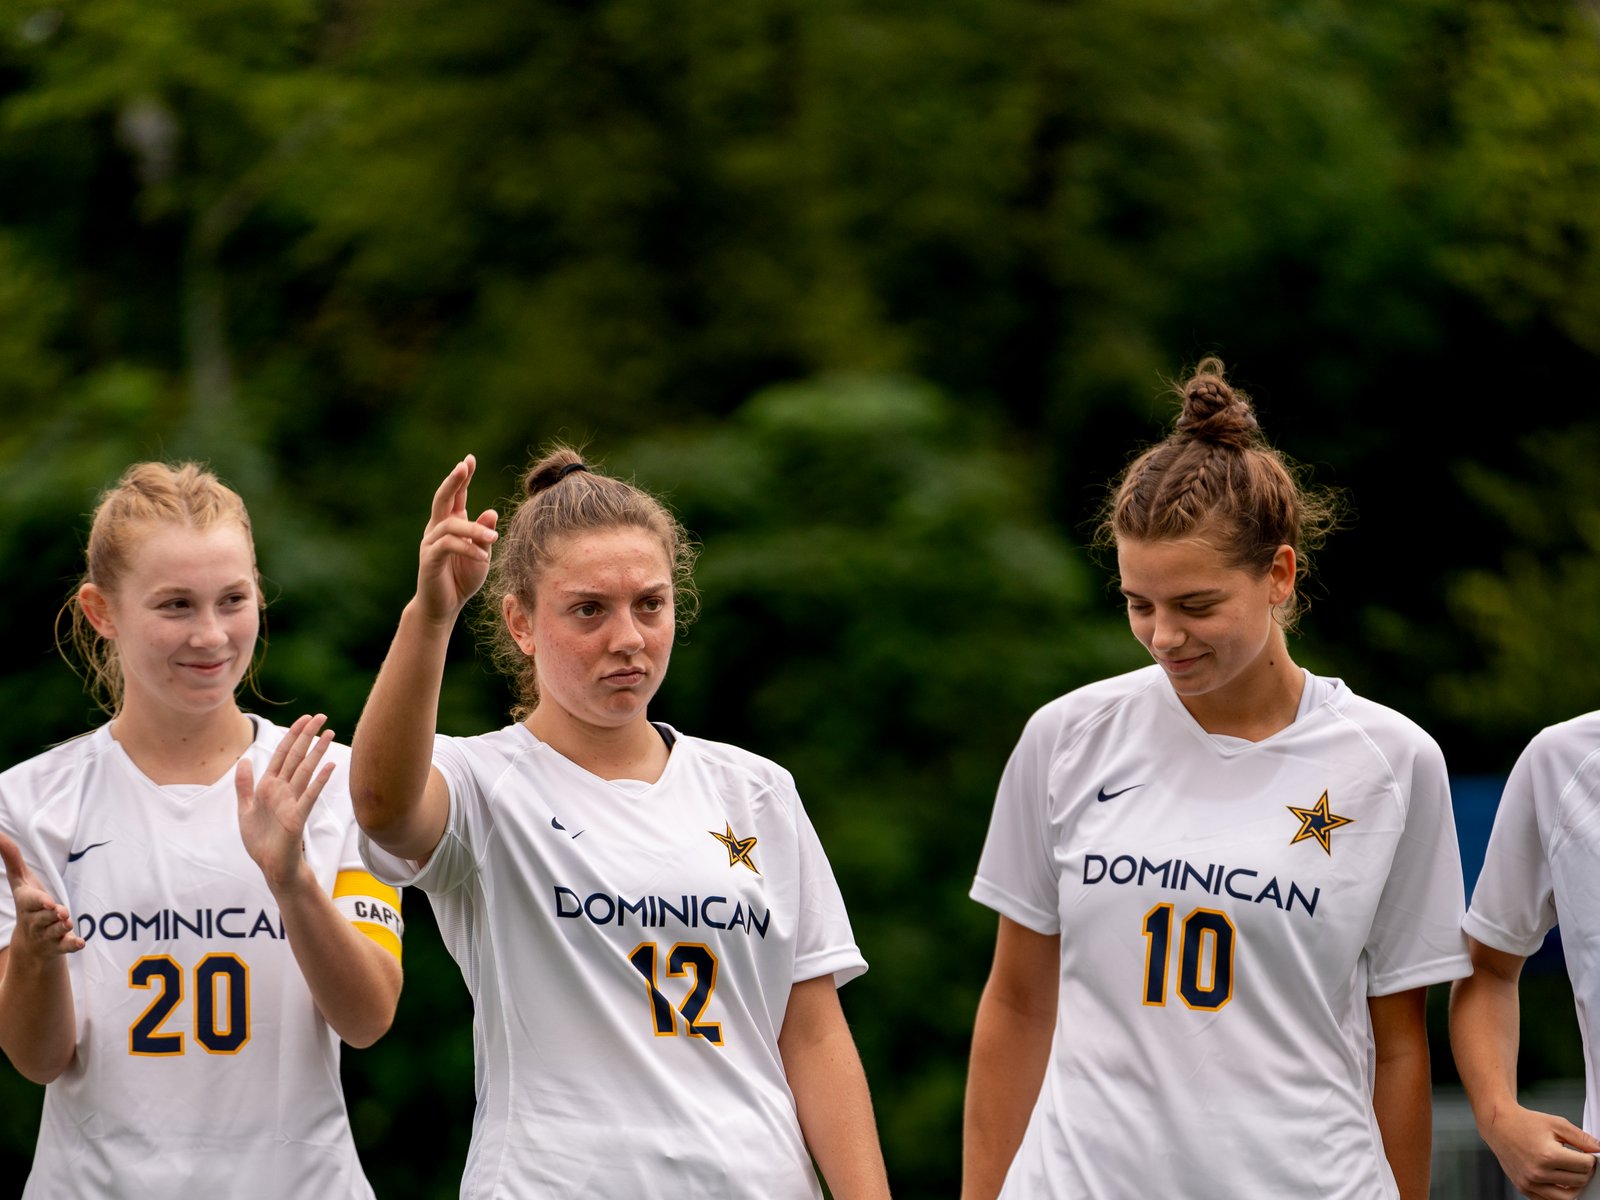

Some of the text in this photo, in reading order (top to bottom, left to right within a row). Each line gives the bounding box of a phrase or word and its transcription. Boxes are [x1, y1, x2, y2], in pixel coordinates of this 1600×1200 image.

[553, 885, 771, 939] DOMINICAN
[1082, 854, 1321, 918] DOMINICAN
[128, 951, 251, 1056] 20
[627, 941, 725, 1047] 12
[1142, 901, 1236, 1012] 10
